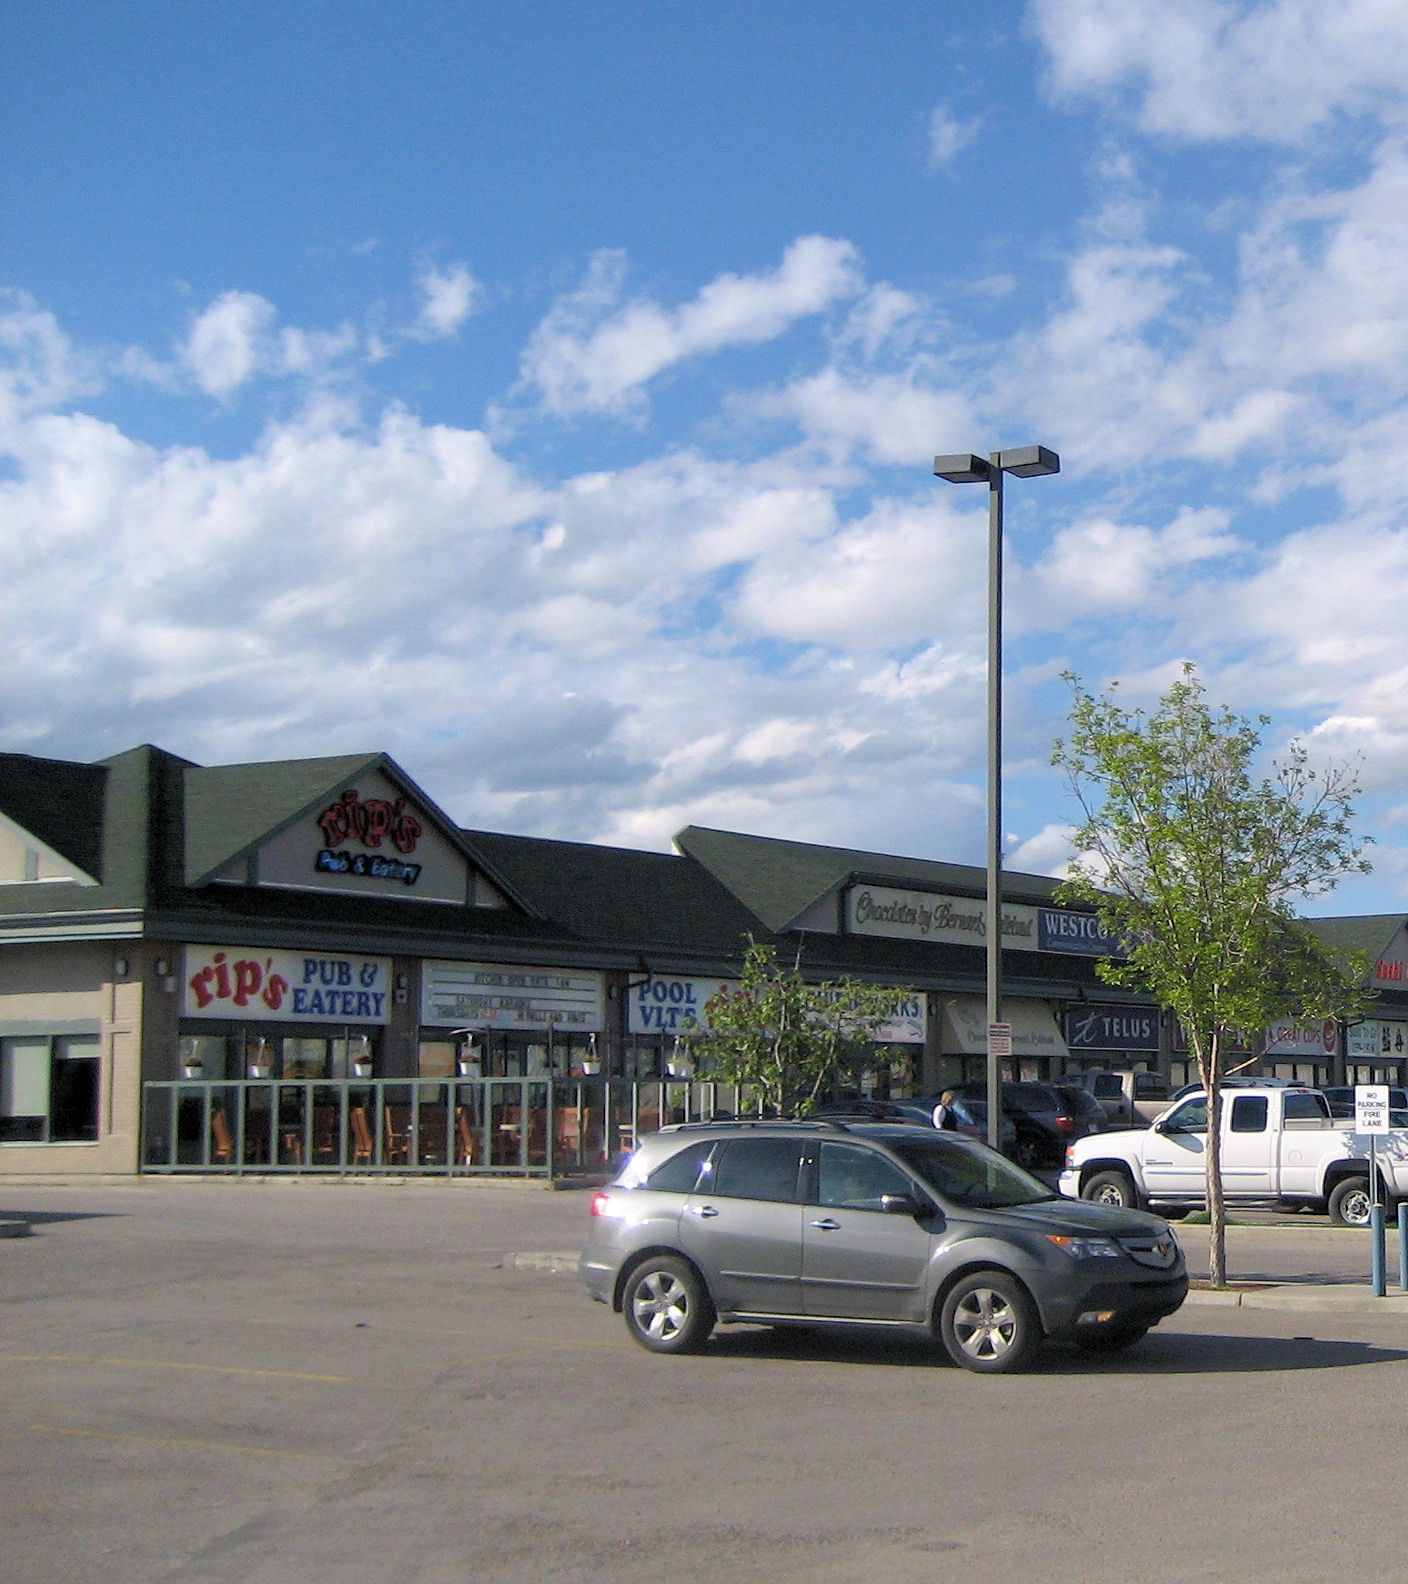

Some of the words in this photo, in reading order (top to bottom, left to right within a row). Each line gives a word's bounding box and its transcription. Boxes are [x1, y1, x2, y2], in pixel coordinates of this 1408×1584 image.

[190, 951, 289, 1010] rip's
[303, 958, 352, 986] PUB
[360, 963, 379, 988] &
[638, 981, 697, 1005] POOL
[292, 987, 386, 1017] EATERY
[1102, 1017, 1151, 1039] TELUS
